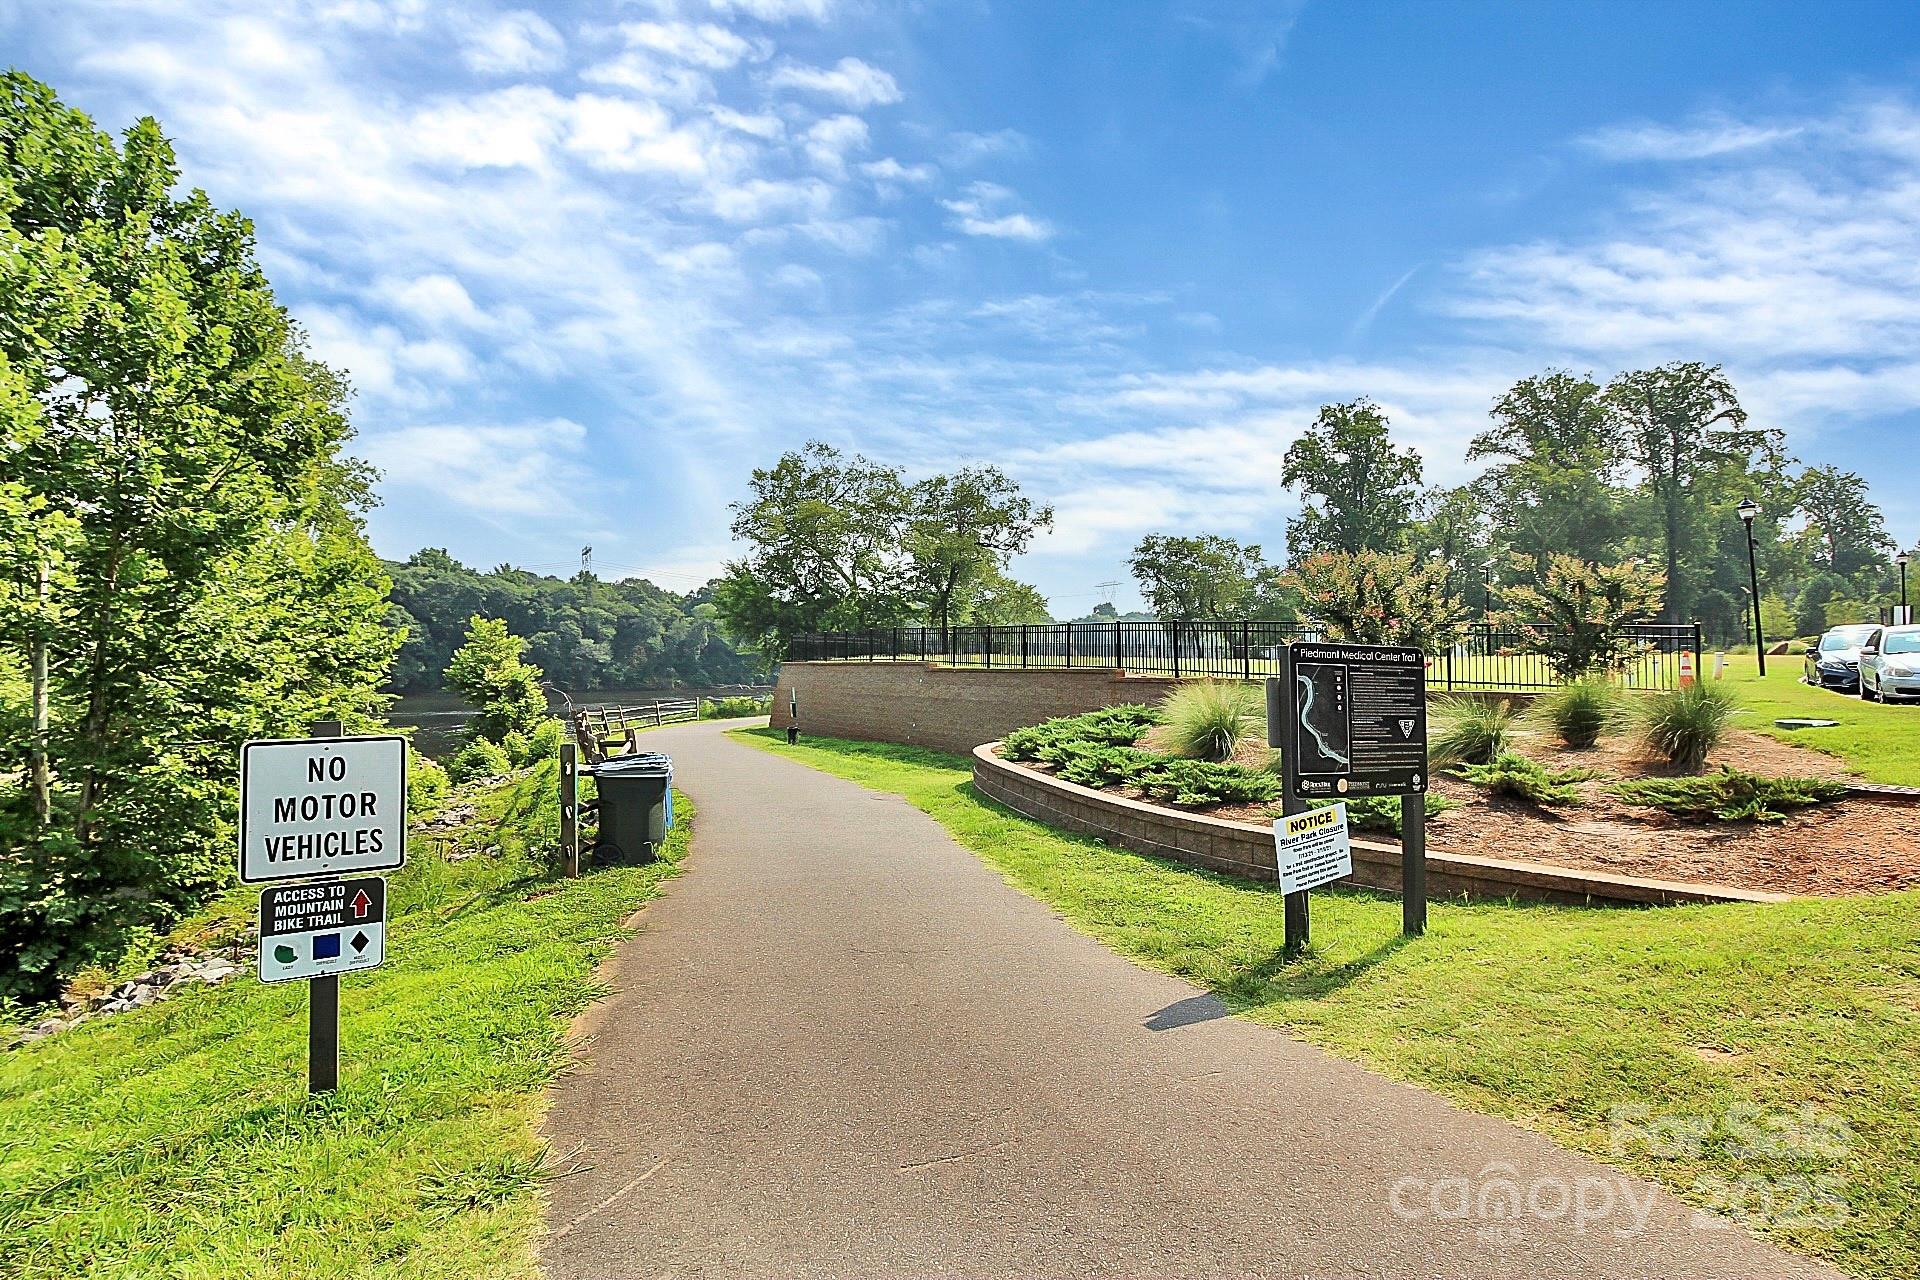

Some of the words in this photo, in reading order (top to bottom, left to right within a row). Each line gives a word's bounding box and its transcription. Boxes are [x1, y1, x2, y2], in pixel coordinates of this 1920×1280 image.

[1300, 648, 1340, 659] Piedmont
[1341, 650, 1374, 661] Medical
[1374, 651, 1401, 662] Center
[1401, 652, 1416, 662] Trail
[308, 756, 346, 782] NO
[274, 792, 377, 823] MOTOR
[1290, 811, 1333, 832] NOTICE
[264, 828, 384, 863] VEHICLES
[1280, 836, 1299, 847] River
[1300, 831, 1317, 841] Park
[1318, 823, 1344, 836] Closure
[273, 887, 325, 904] ACCESS
[328, 885, 346, 898] TO
[274, 898, 344, 918] MOUNTAIN
[273, 917, 304, 932] BIKE
[306, 912, 345, 927] TRAIL
